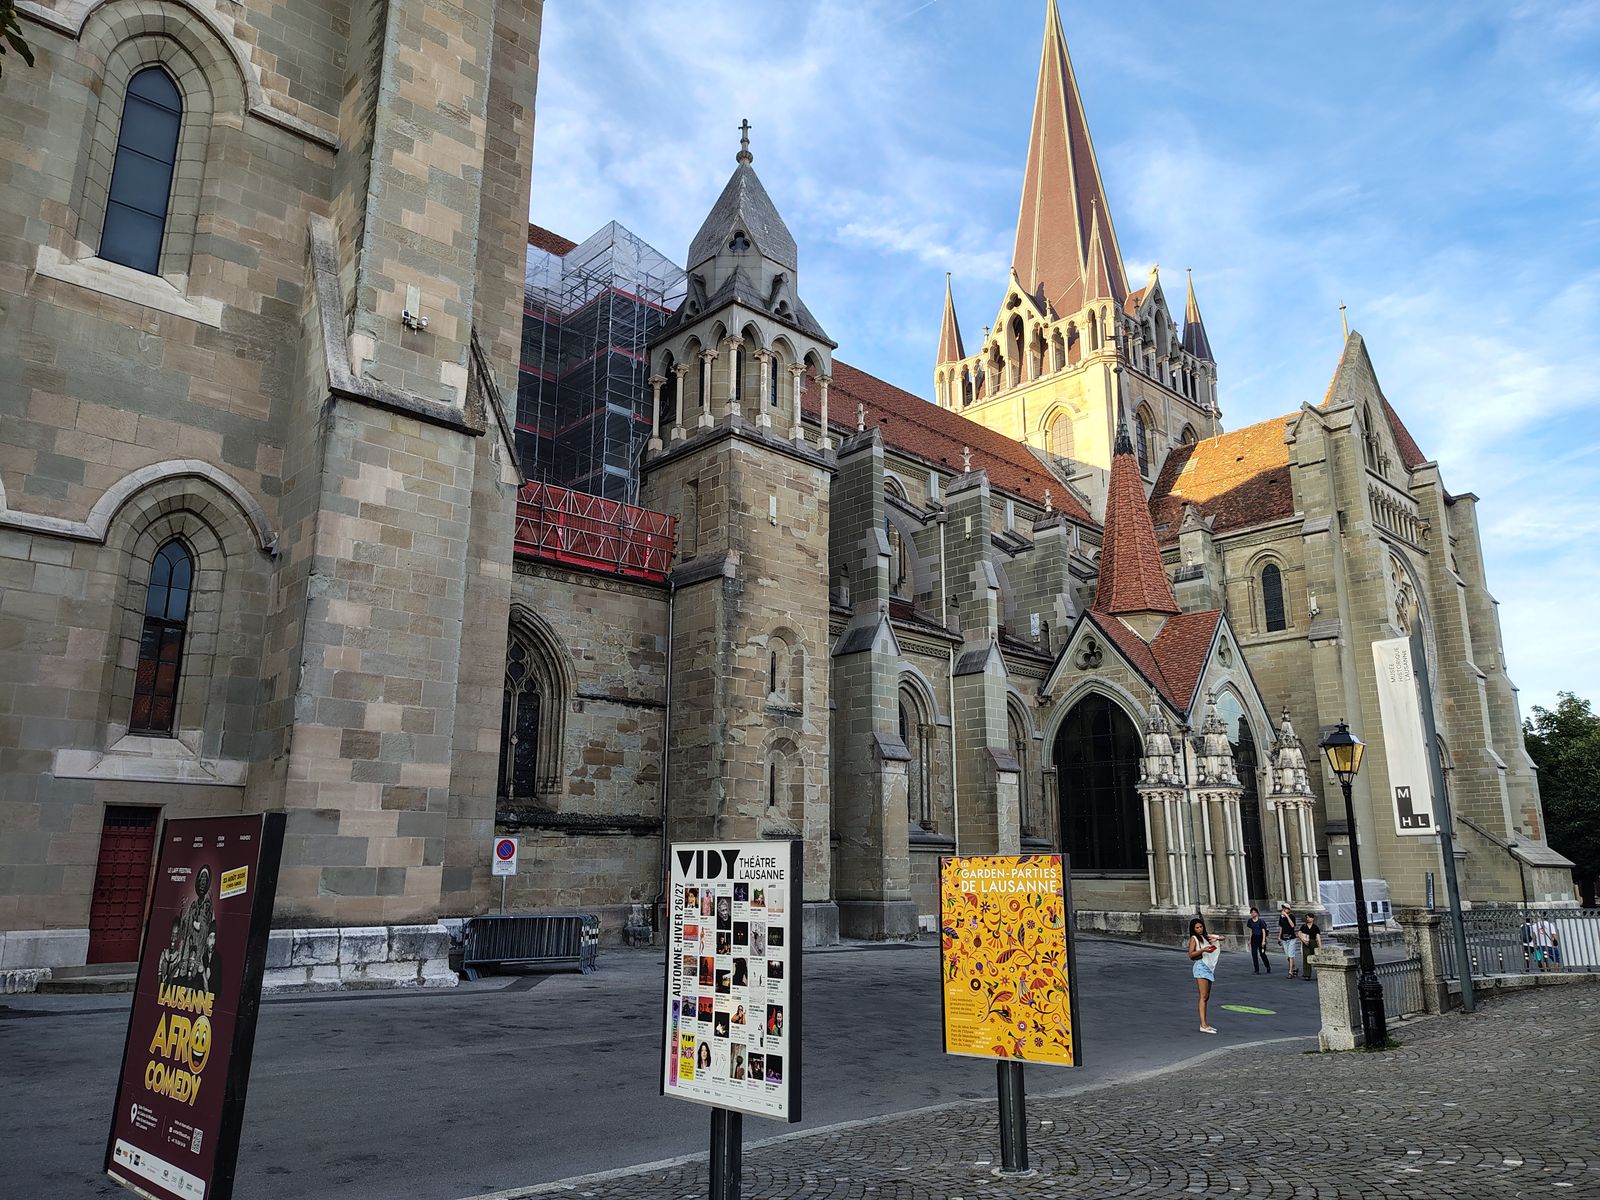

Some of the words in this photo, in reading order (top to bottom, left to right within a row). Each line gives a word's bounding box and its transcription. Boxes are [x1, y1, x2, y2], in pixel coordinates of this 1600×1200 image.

[1402, 650, 1410, 681] LAUSANNE
[676, 849, 741, 879] VIDY
[739, 855, 776, 868] THÉÂTRE
[740, 869, 785, 880] LAUSANNE
[961, 868, 1056, 879] GARDEN-PARTIES
[674, 882, 685, 911] 26/27
[961, 880, 976, 893] DE
[981, 880, 1057, 893] LAUSANNE
[672, 913, 684, 997] AUTOMNE-HIVER
[158, 982, 215, 1018] LAUSANNE
[144, 1060, 202, 1107] COMEDY
